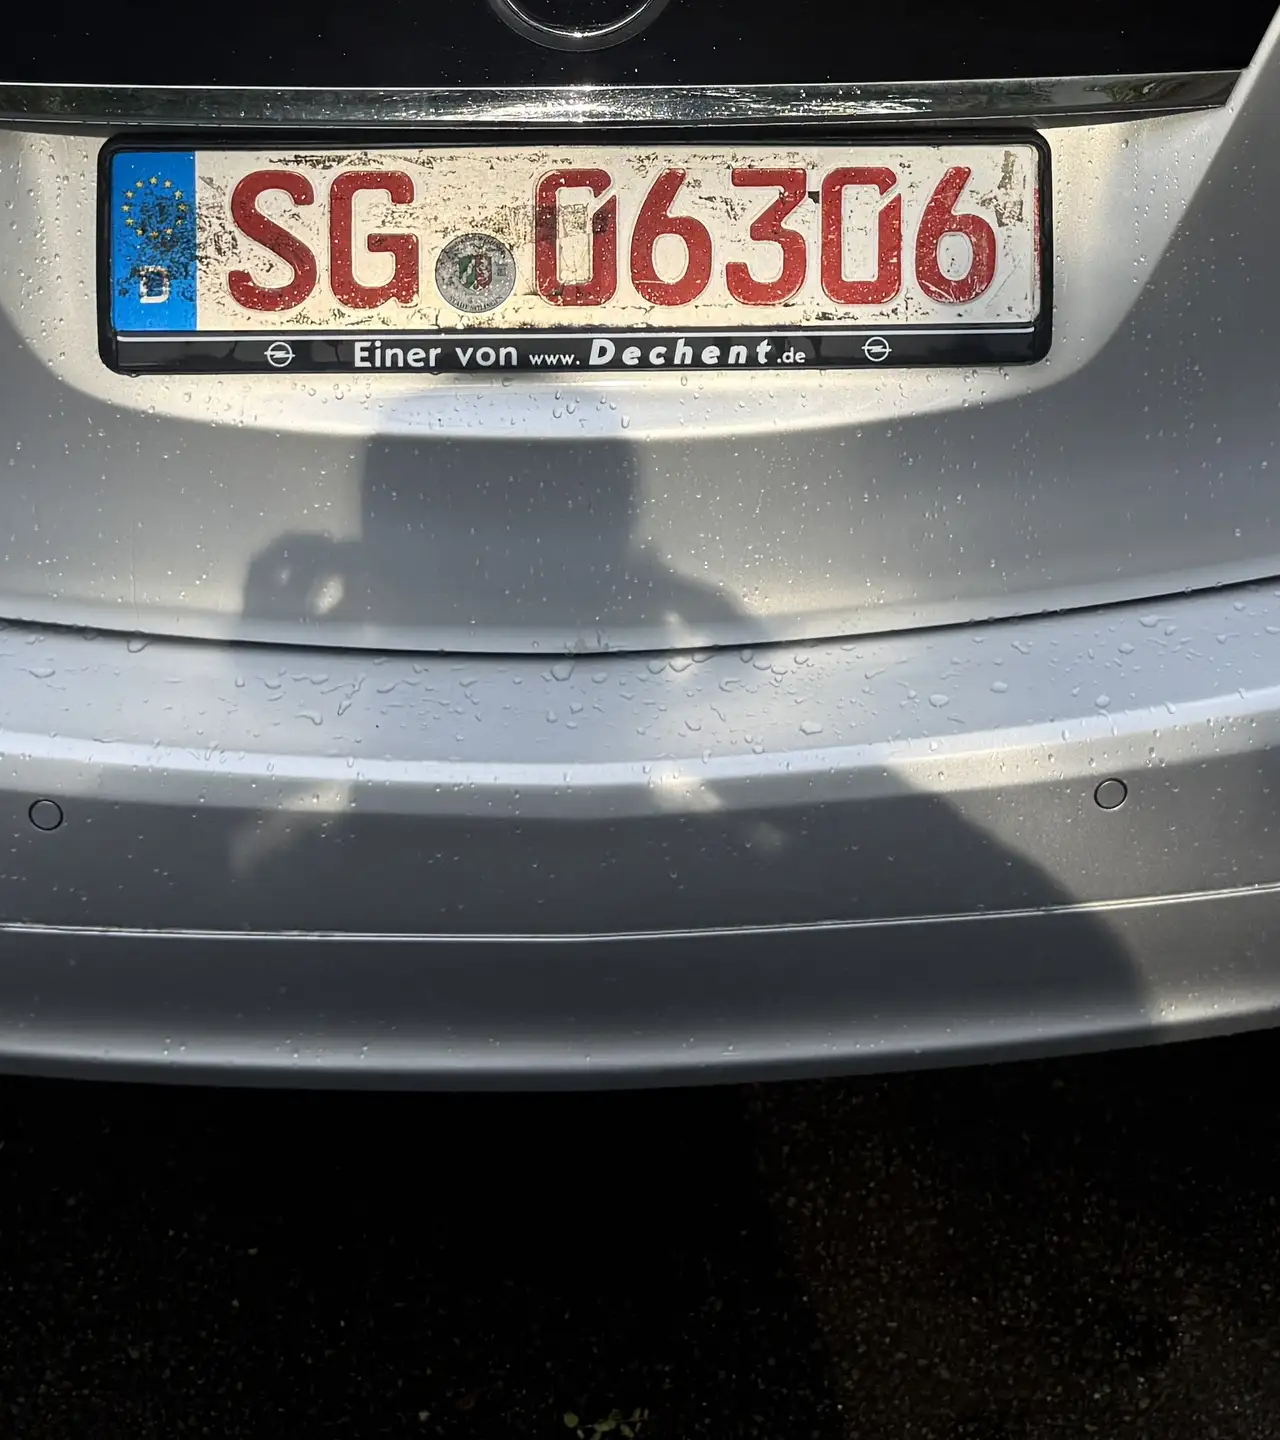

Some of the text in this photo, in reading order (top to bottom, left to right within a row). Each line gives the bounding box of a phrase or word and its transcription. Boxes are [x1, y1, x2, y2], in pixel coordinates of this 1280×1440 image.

[228, 166, 997, 312] SG 06306
[139, 265, 170, 304] D
[353, 340, 442, 368] Einer
[455, 346, 518, 367] von
